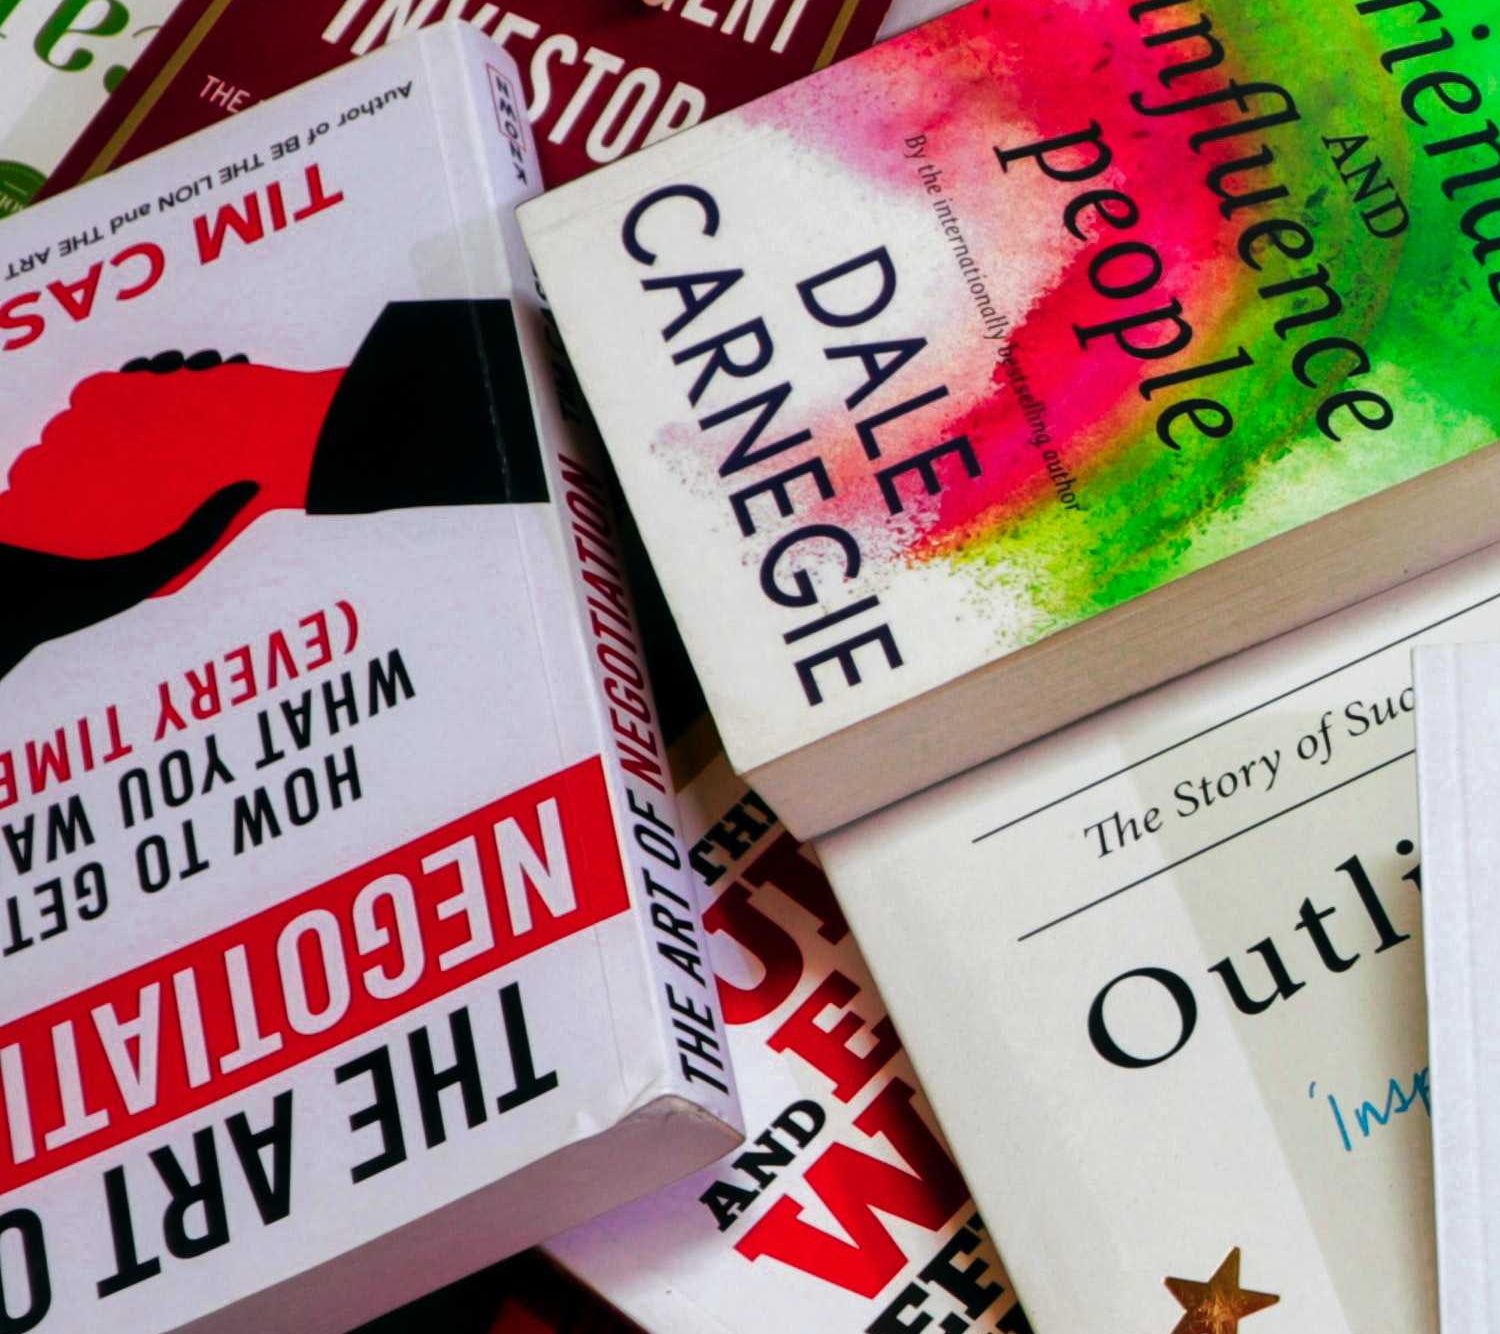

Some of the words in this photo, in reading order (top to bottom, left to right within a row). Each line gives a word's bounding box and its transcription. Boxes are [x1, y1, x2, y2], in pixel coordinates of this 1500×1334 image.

[199, 162, 347, 265] TIM
[1322, 132, 1411, 240] AND
[1000, 120, 1234, 451] people
[621, 182, 905, 707] CARNEGIE
[797, 244, 982, 517] DALE
[137, 833, 210, 894] TO
[234, 748, 364, 835] HOW
[1084, 802, 1163, 861] The
[1173, 756, 1285, 824] Story
[350, 982, 561, 1181] THE
[96, 1092, 297, 1298] ART
